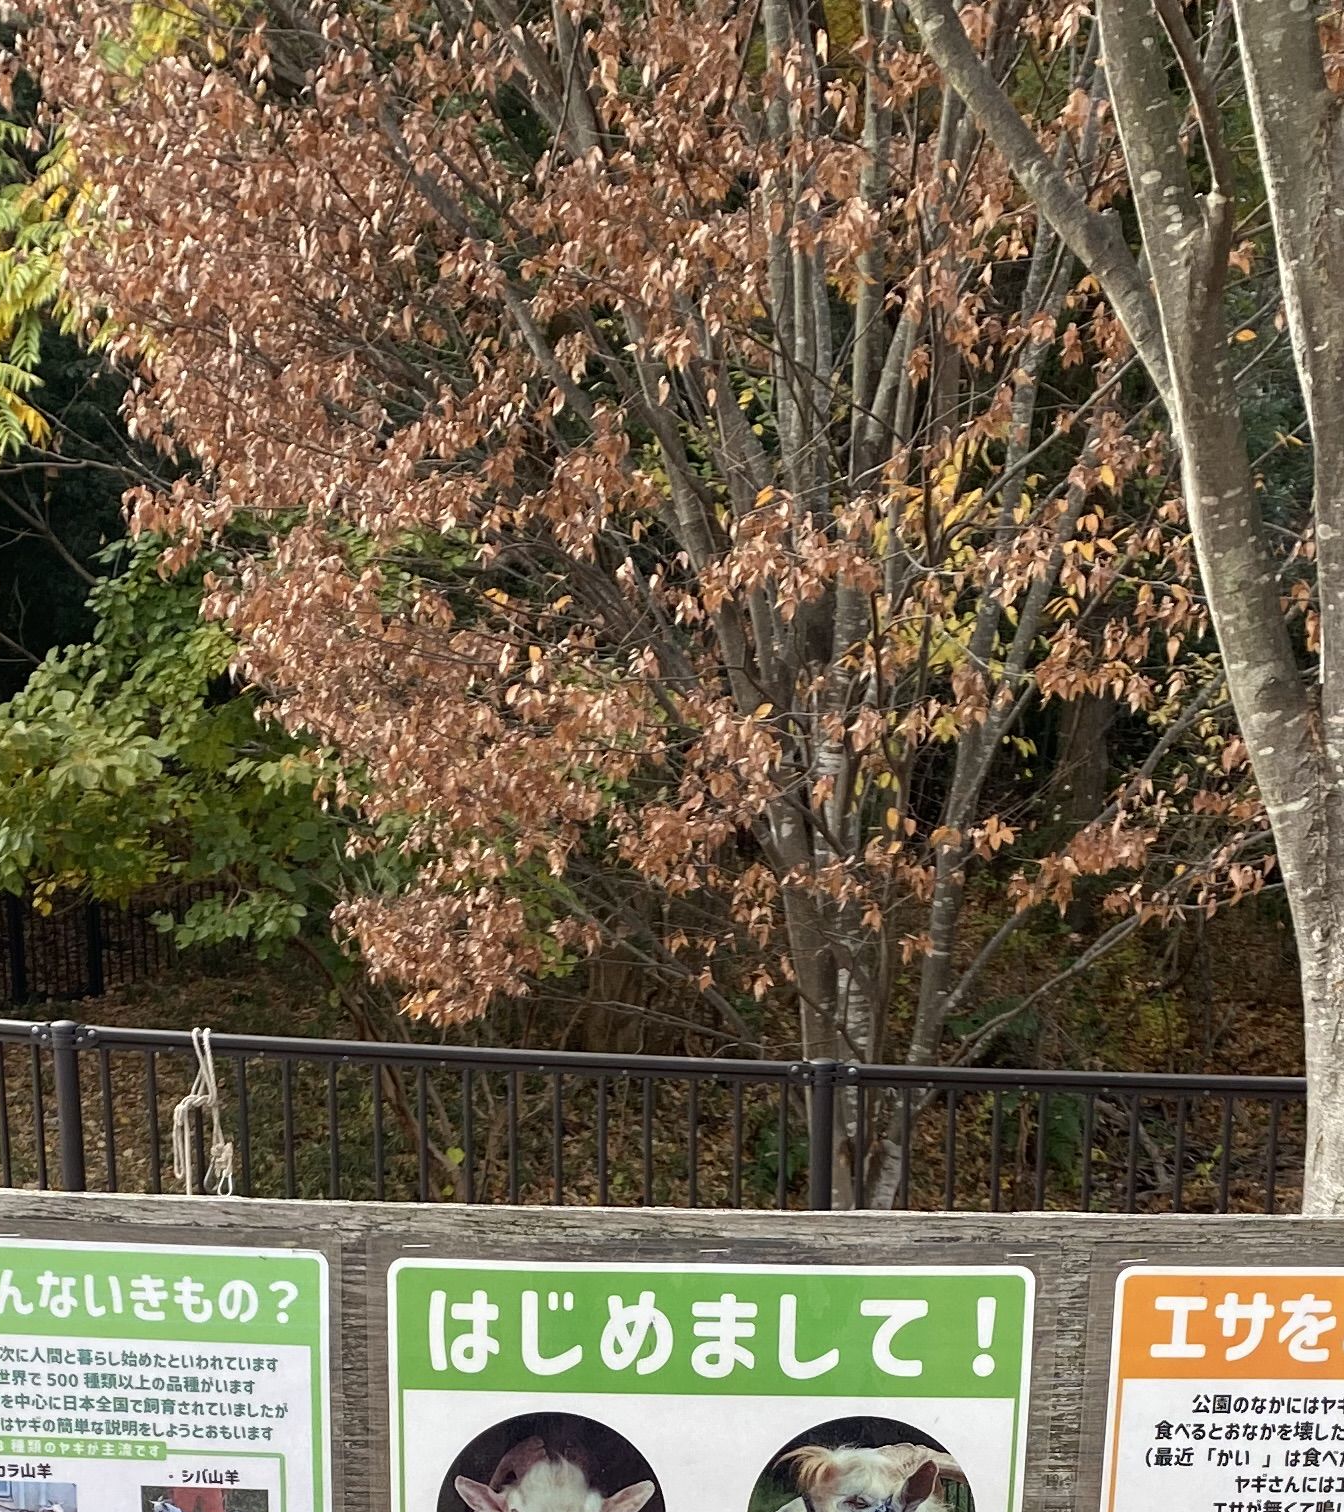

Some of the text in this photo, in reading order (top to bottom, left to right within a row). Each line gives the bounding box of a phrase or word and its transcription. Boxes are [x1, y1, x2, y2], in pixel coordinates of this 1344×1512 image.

[427, 1289, 997, 1380] はじめまして！
